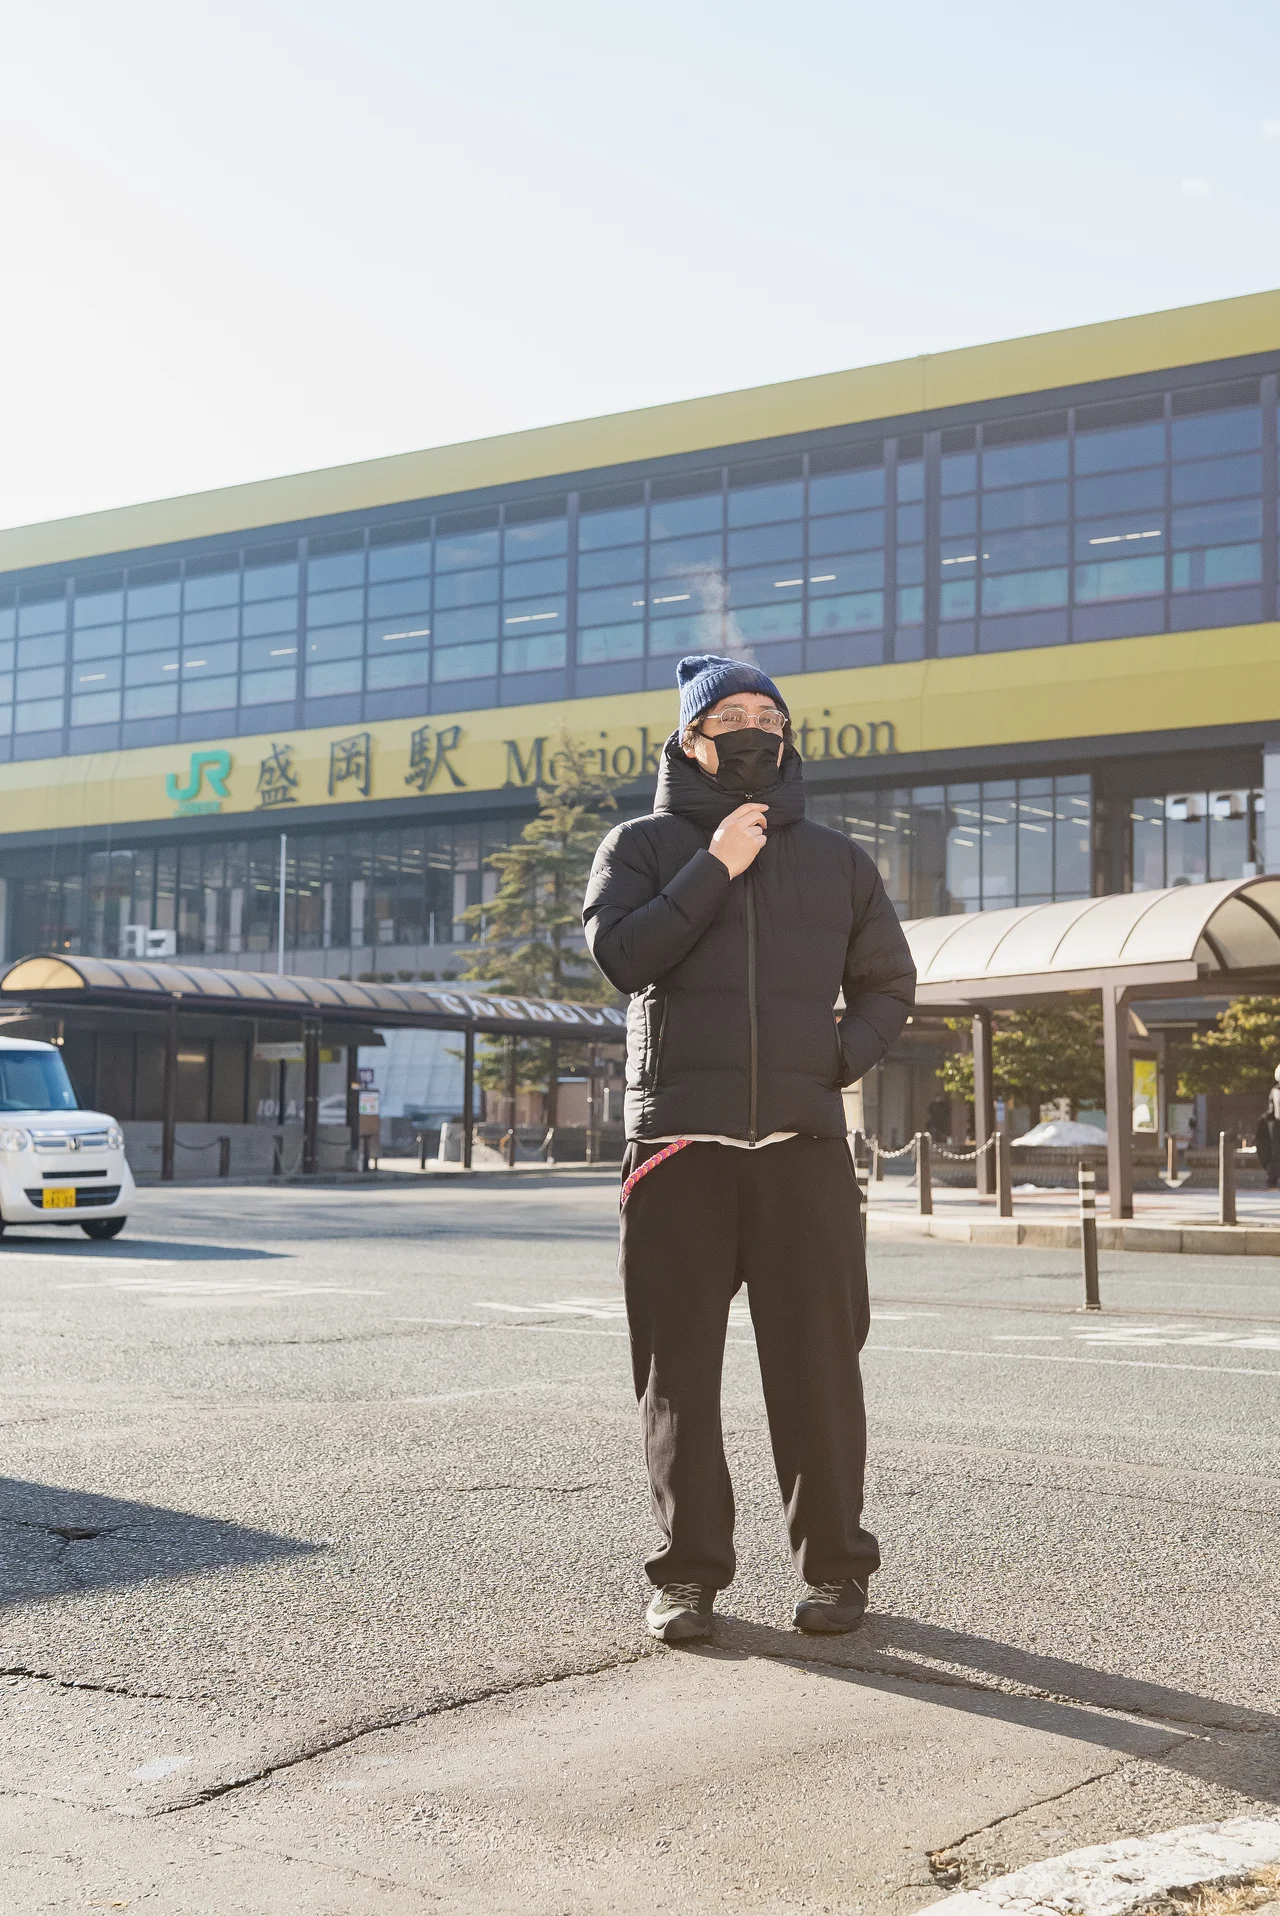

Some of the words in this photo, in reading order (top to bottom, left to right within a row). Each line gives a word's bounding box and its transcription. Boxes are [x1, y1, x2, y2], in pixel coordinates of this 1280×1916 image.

[166, 749, 230, 801] JR
[255, 723, 468, 811] 盛岡駅
[502, 727, 664, 789] Moriok
[798, 708, 898, 760] tion
